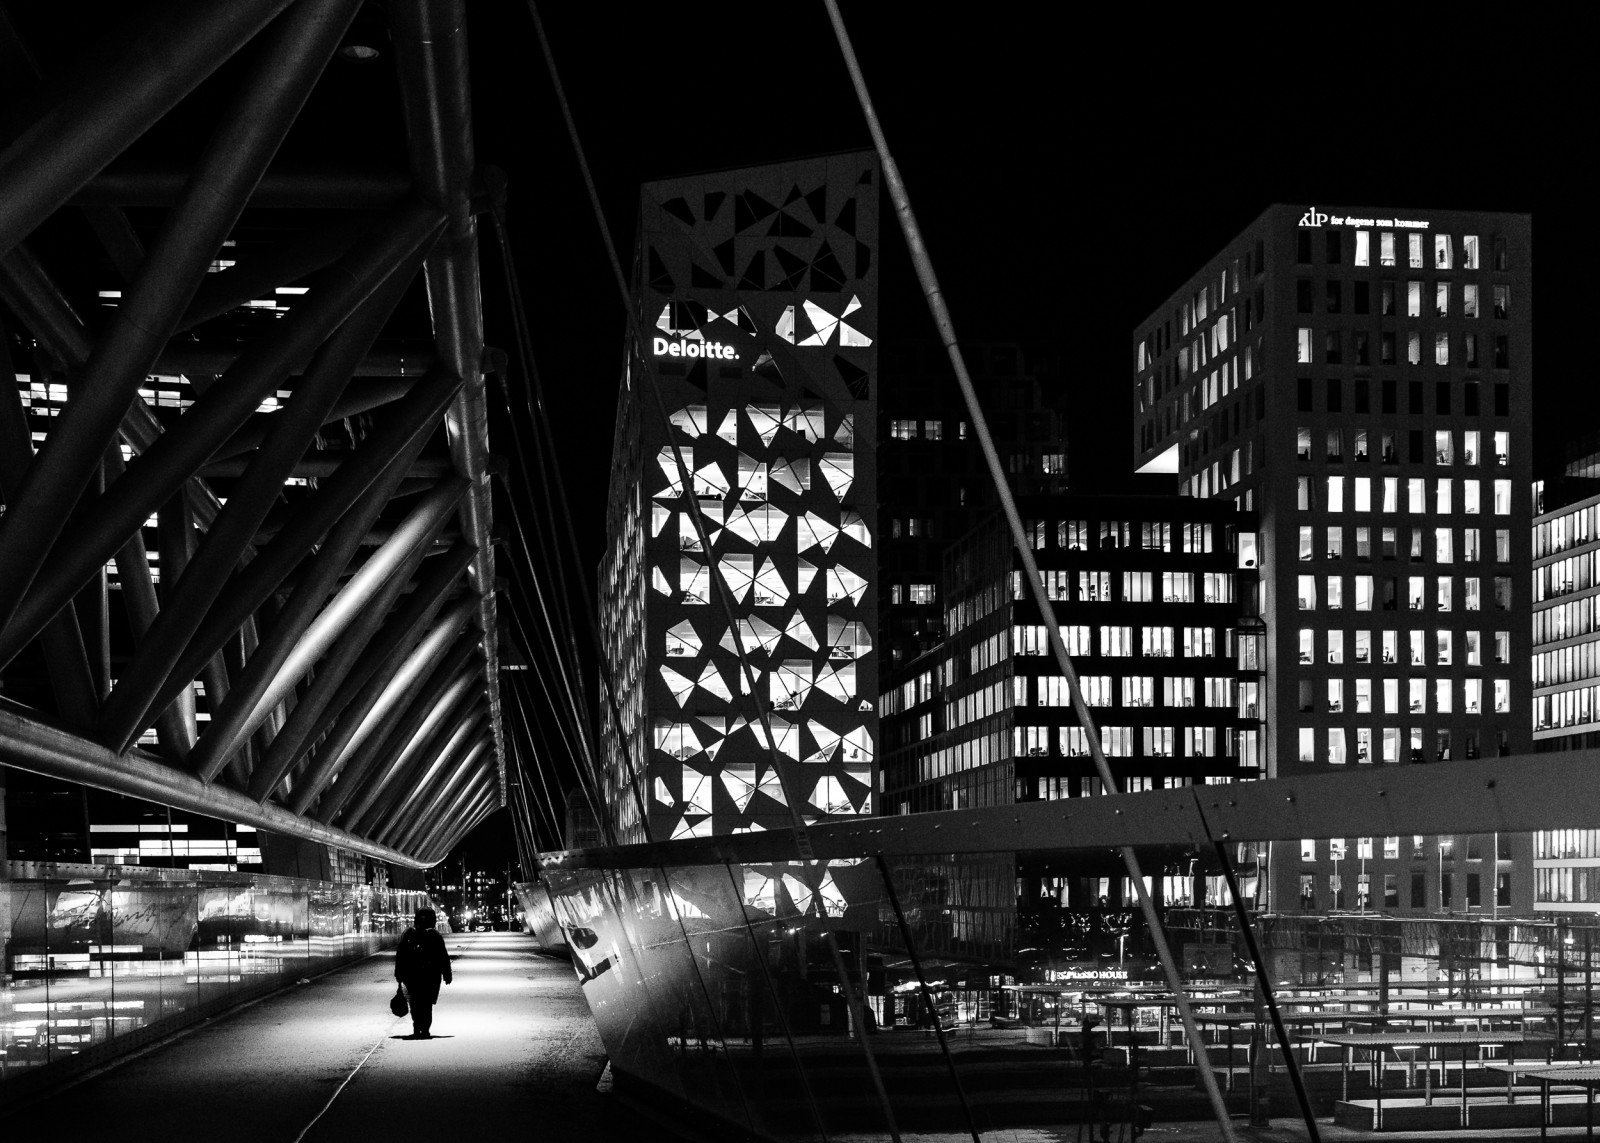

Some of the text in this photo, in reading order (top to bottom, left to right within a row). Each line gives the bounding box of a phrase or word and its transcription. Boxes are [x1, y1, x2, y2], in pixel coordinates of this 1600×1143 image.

[1330, 215, 1344, 225] for
[1345, 216, 1375, 228] dagene
[1376, 218, 1393, 227] som
[1394, 218, 1429, 228] kommer
[653, 337, 740, 360] Deloitte.
[1099, 970, 1128, 979] HOUSE
